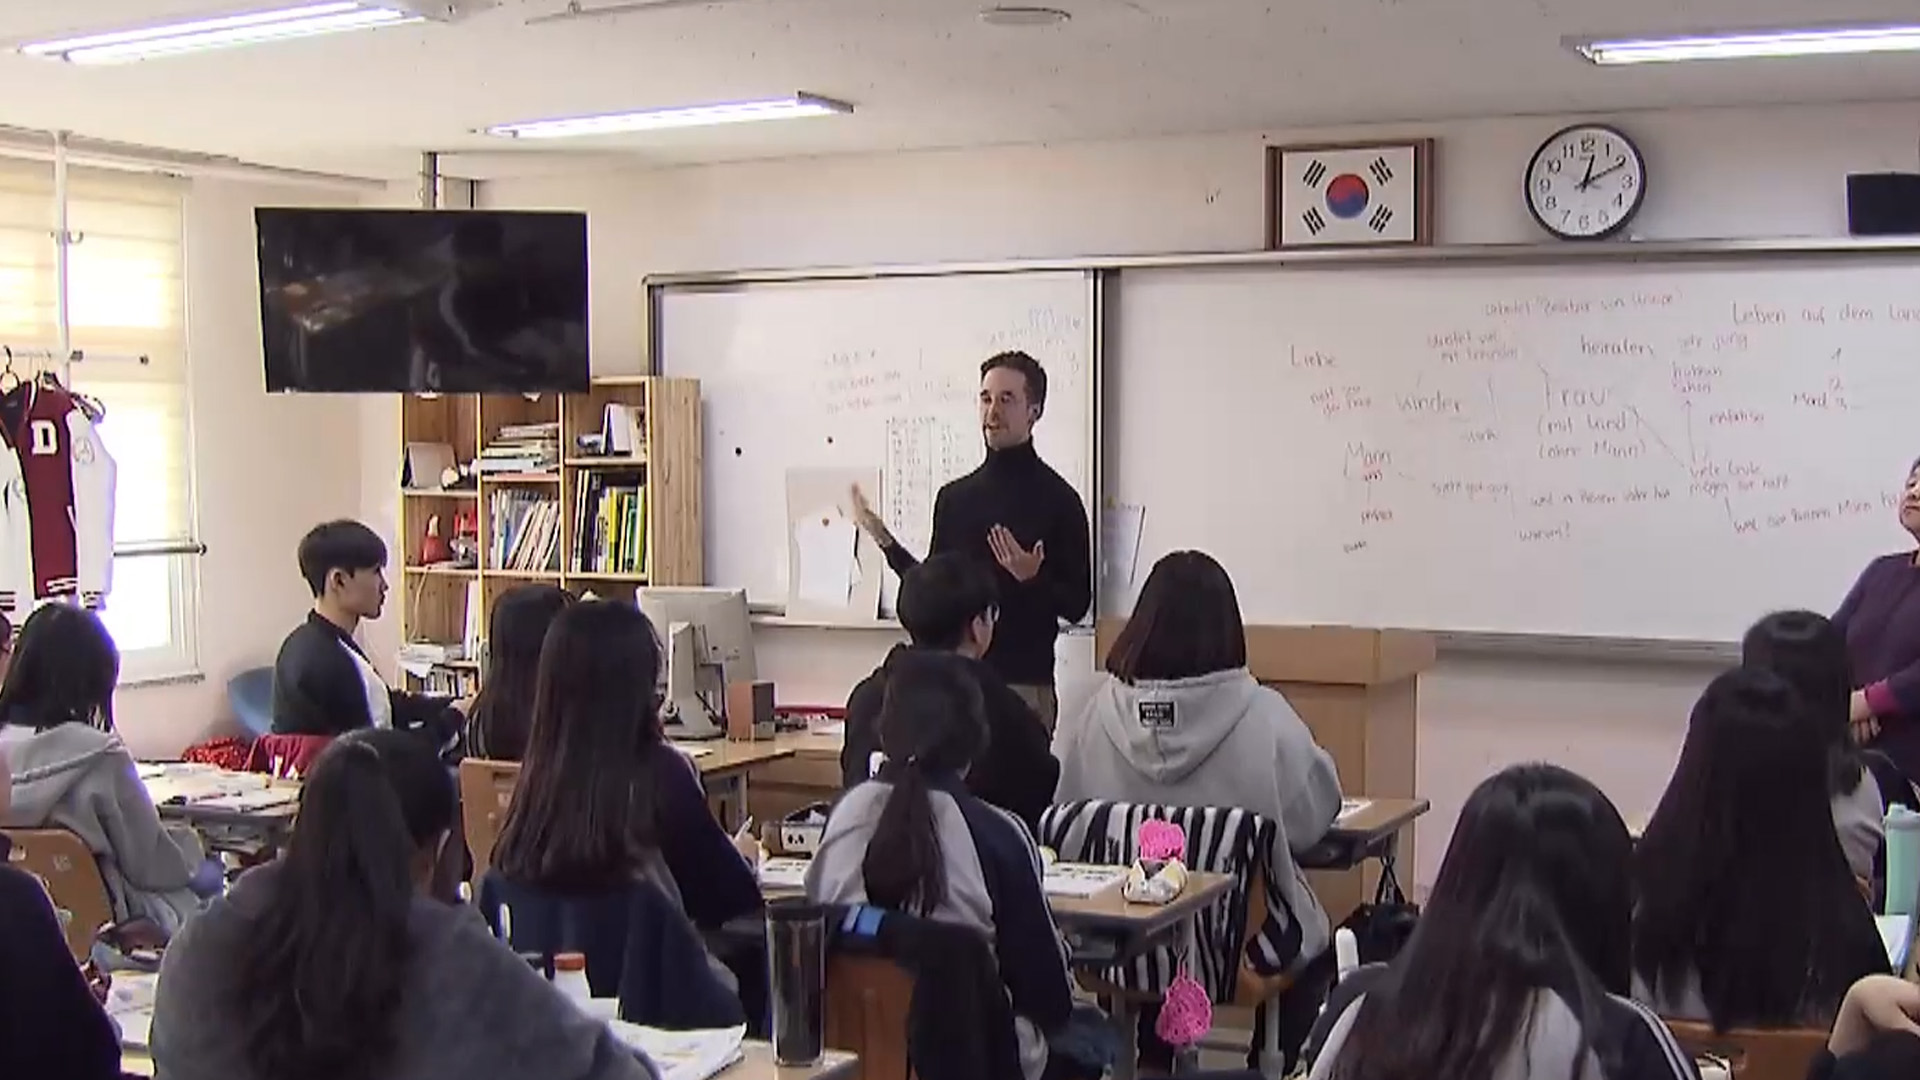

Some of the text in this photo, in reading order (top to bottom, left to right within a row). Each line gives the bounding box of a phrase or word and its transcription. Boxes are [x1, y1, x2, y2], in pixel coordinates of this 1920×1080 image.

[1563, 144, 1574, 158] 11
[1580, 137, 1595, 152] 12
[1605, 143, 1610, 157] 1
[1548, 160, 1561, 174] 10
[1615, 154, 1626, 167] 2
[1540, 179, 1551, 193] 9
[1622, 175, 1633, 189] 3
[1545, 196, 1557, 210] 8
[1613, 193, 1622, 208] 4
[1561, 210, 1571, 224] 7
[1579, 215, 1589, 230] 6
[1599, 209, 1609, 223] 5
[1731, 302, 1785, 326] Leben
[1801, 305, 1825, 325] auf
[1839, 303, 1873, 321] dem
[1290, 344, 1338, 368] Liebe
[31, 419, 59, 456] D
